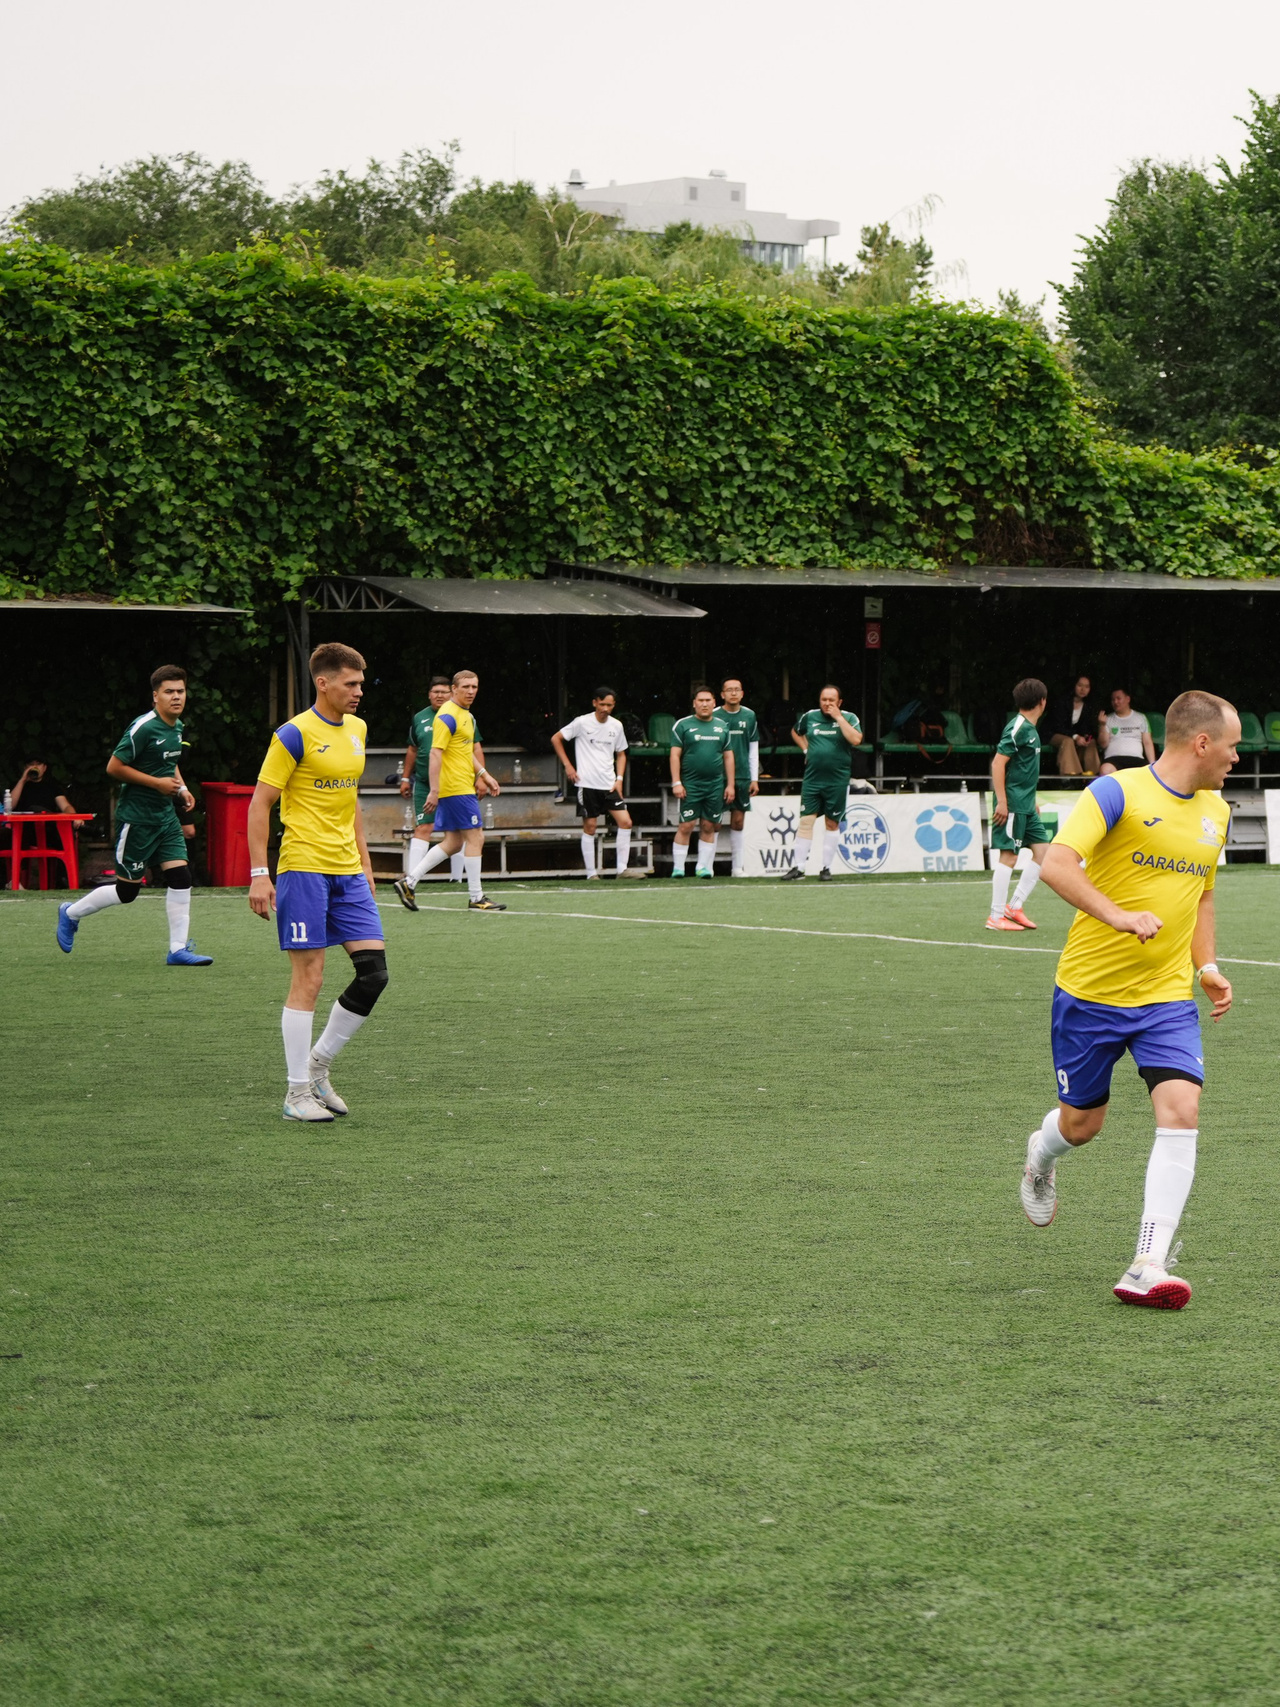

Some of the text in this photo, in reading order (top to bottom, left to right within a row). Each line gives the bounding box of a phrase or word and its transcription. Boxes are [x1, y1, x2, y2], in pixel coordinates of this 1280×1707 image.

[683, 809, 694, 817] 20
[471, 815, 479, 825] 8
[843, 832, 880, 845] KMFF
[132, 861, 145, 871] 14
[922, 855, 969, 872] EMF
[290, 922, 308, 942] 11
[1057, 1068, 1070, 1095] 9
